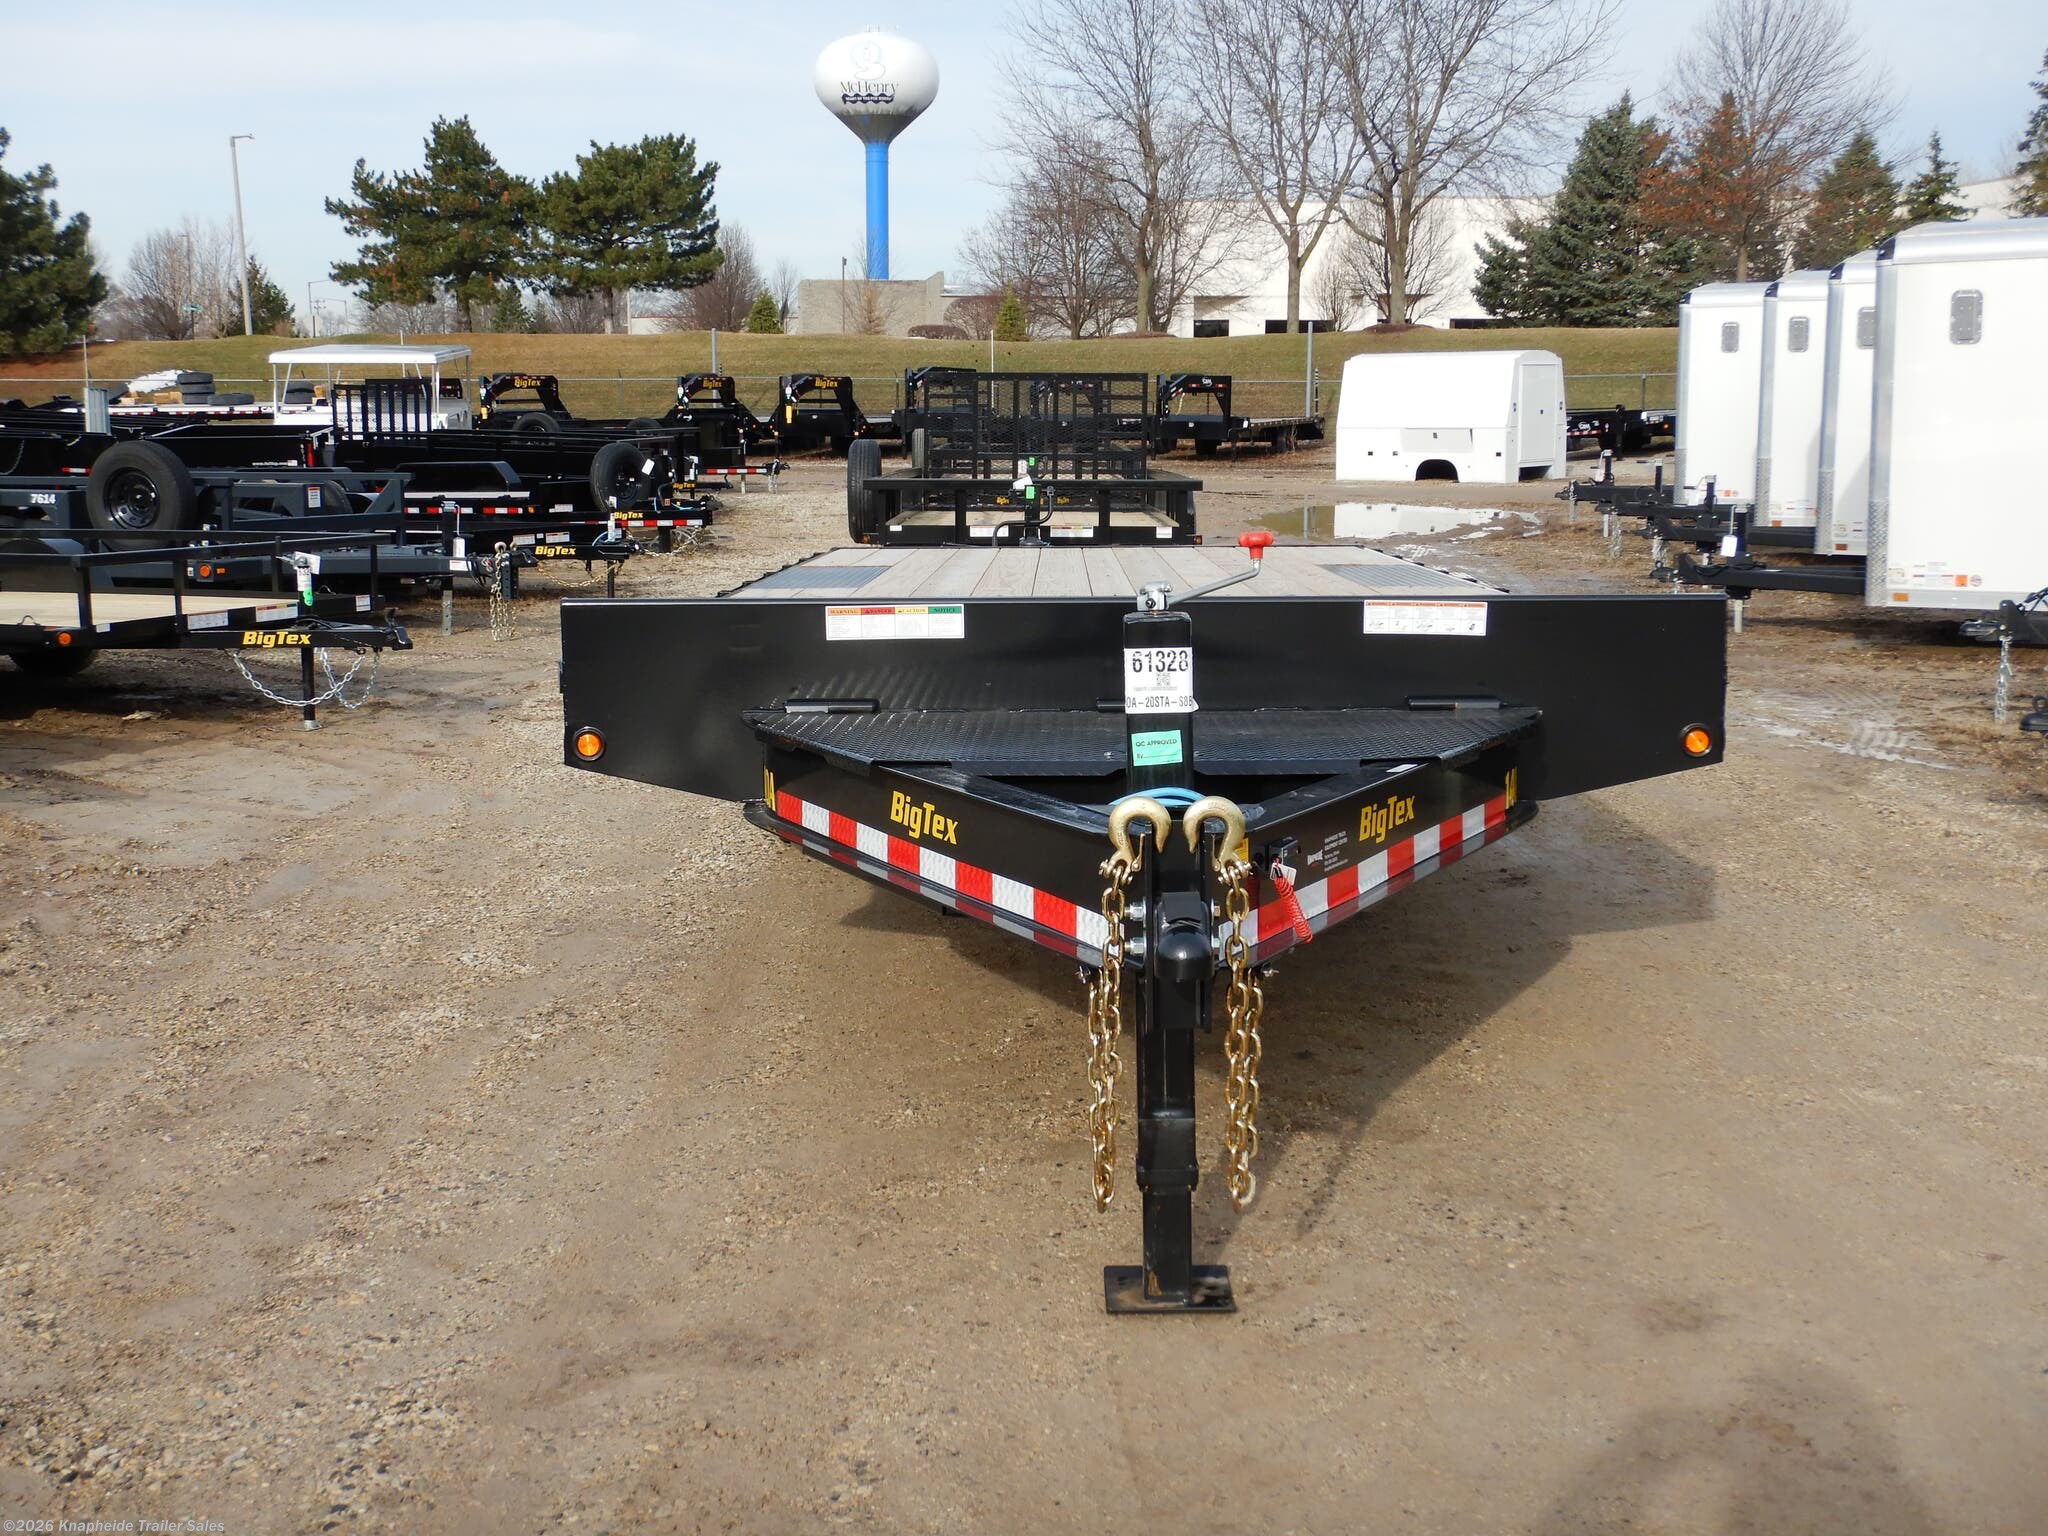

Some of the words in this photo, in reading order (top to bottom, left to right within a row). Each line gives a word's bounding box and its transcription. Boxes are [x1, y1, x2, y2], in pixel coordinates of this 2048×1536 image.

[840, 81, 898, 94] McHenry
[31, 493, 56, 504] 7614
[535, 545, 576, 557] BigTex
[242, 631, 312, 648] BigTex
[1132, 650, 1188, 672] 61328
[890, 790, 959, 845] BigTex
[1359, 795, 1416, 844] BigTex
